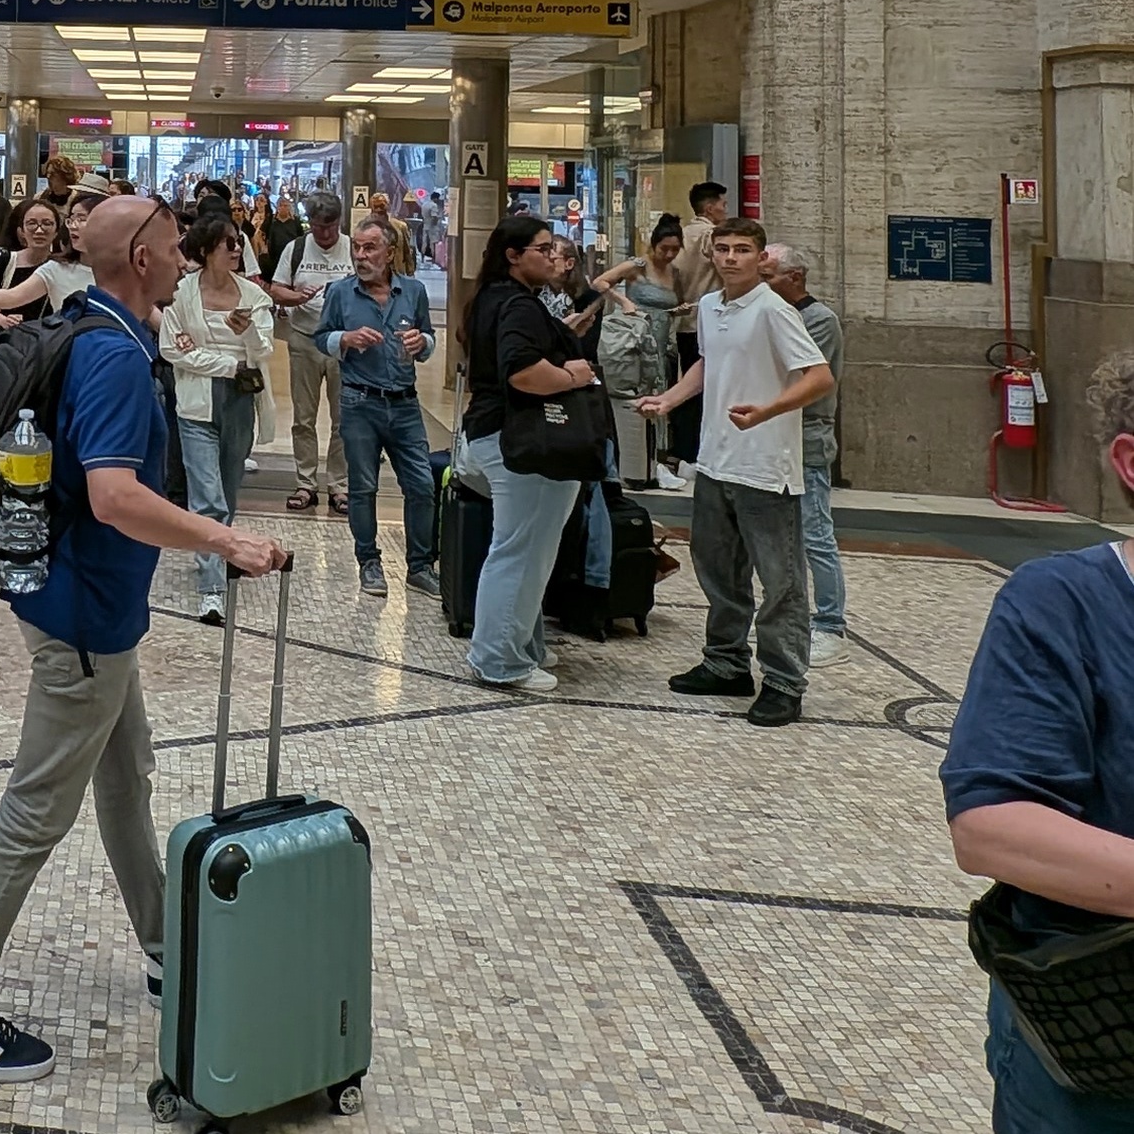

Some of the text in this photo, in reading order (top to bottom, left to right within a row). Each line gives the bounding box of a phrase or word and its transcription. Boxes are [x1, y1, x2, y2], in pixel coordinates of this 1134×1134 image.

[471, 1, 602, 16] Malpensa Aeroporto
[464, 144, 485, 152] GATE
[463, 152, 485, 176] A
[12, 181, 25, 196] A
[354, 193, 367, 207] A
[305, 263, 346, 272] REPLAY
